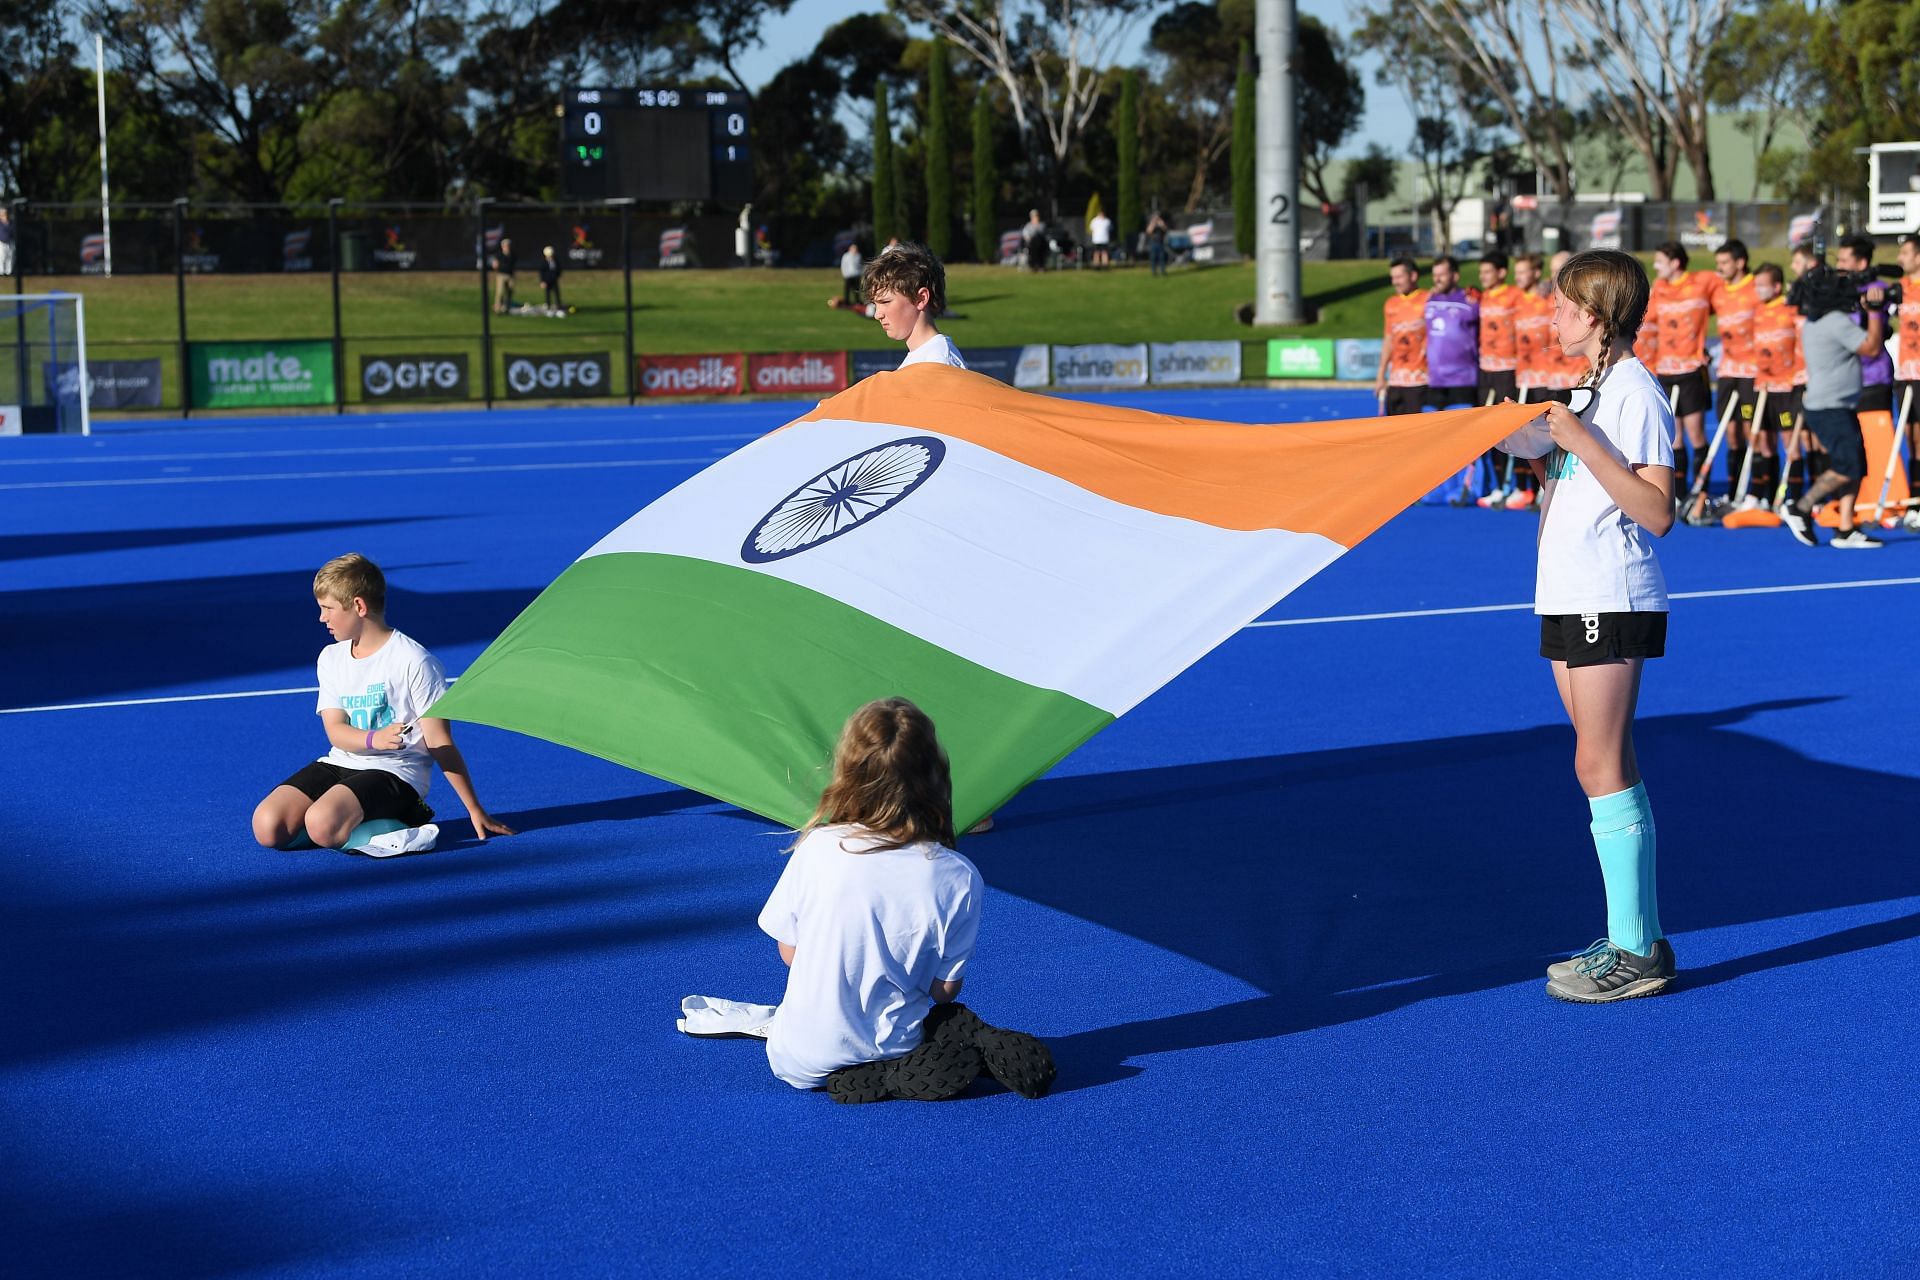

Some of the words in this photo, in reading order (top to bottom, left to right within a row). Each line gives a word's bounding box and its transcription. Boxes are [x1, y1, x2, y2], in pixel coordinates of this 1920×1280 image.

[584, 112, 601, 135] 0
[727, 113, 744, 136] 0
[1270, 194, 1289, 224] 2
[395, 361, 460, 389] GFG
[537, 360, 601, 388] GFG
